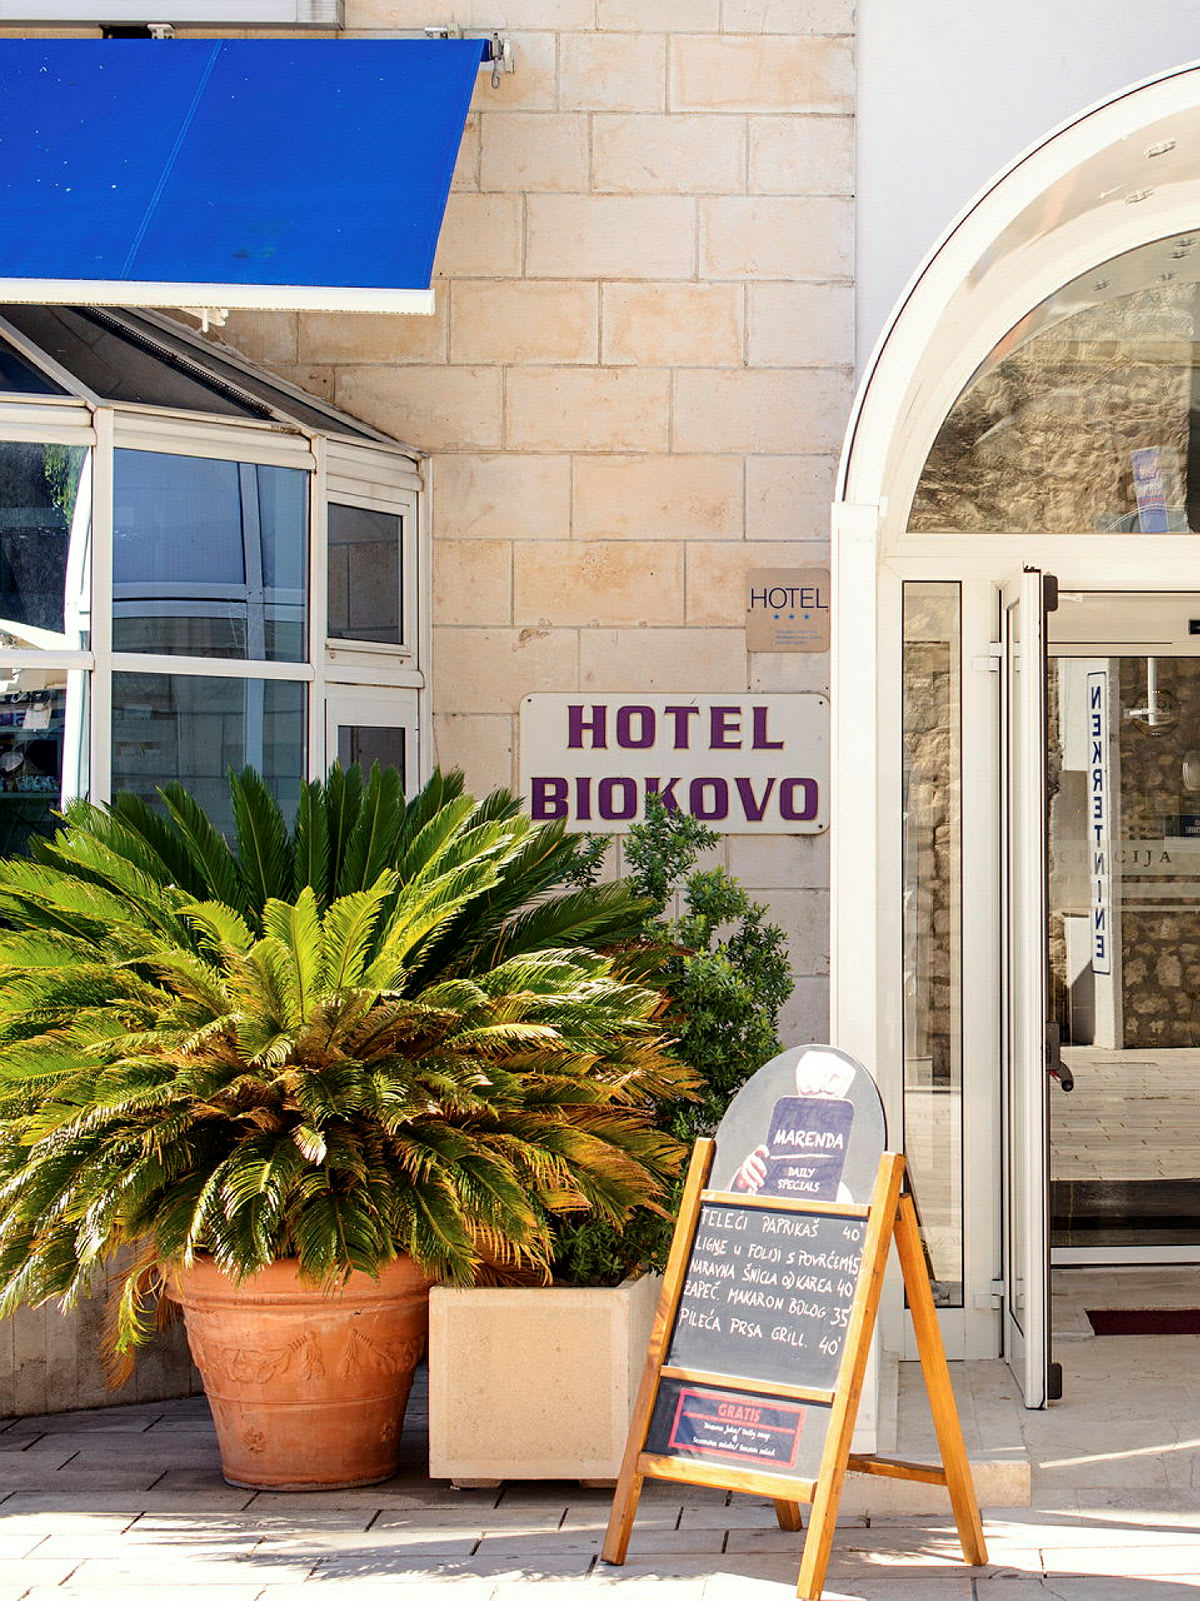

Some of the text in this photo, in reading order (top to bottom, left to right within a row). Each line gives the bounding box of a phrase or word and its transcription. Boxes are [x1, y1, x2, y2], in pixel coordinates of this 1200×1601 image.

[750, 587, 829, 609] HOTEL
[567, 704, 784, 750] HOTEL
[530, 777, 819, 822] BIOKOVO
[773, 1128, 844, 1149] MARENDA
[788, 1166, 816, 1178] DAILY
[777, 1179, 820, 1193] SPECIALS
[700, 1207, 748, 1230] TELEĆI
[762, 1215, 820, 1238] PAPRIKAŠ
[748, 1243, 782, 1262] FOLIJI
[689, 1257, 735, 1280] NARAVNA
[742, 1263, 778, 1286] ŠNICLA
[796, 1274, 833, 1293] KAREA
[727, 1288, 784, 1310] MAKARON
[678, 1307, 721, 1332] PILEĆA
[730, 1318, 763, 1338] PRSA
[717, 1402, 761, 1423] GRATIS
